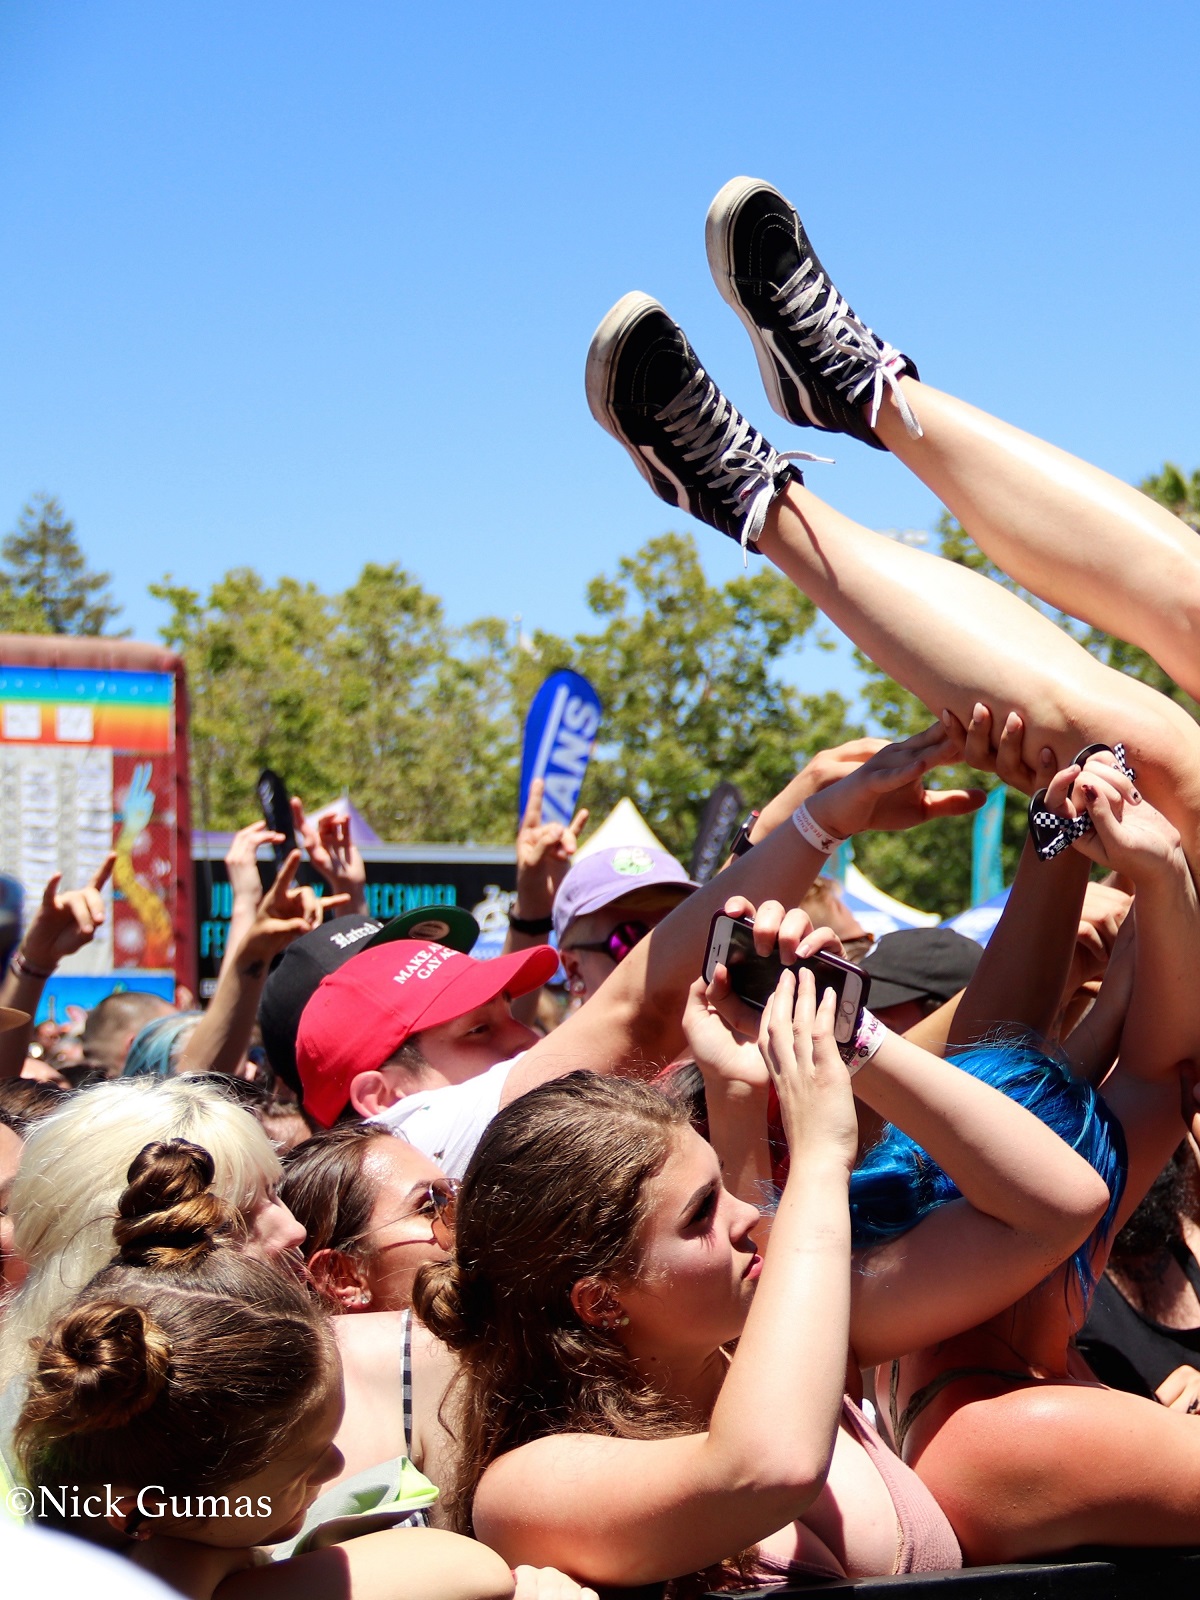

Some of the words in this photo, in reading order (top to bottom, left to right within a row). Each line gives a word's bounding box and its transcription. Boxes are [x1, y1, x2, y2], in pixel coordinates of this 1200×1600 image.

[797, 815, 809, 833] ENJO
[800, 809, 822, 838] RESPONS
[393, 950, 433, 984] MAKE
[417, 957, 443, 979] GAY
